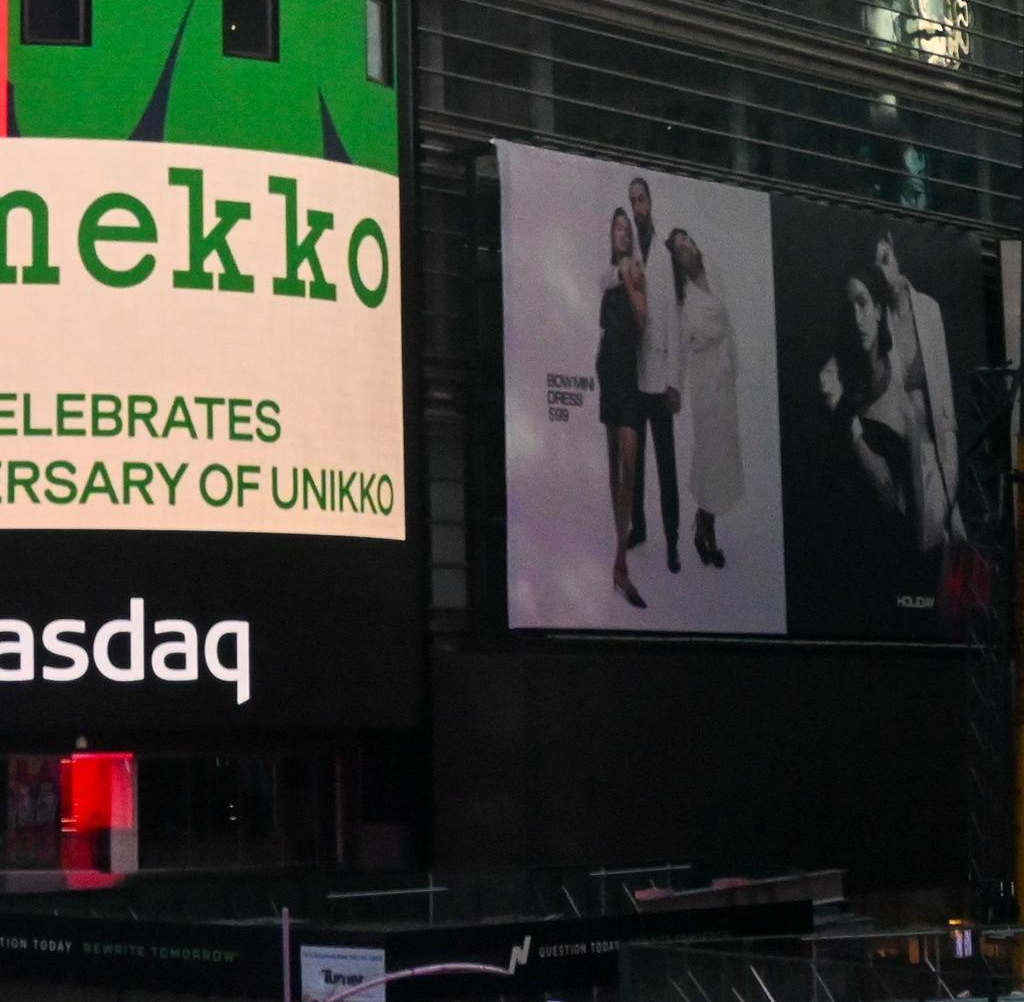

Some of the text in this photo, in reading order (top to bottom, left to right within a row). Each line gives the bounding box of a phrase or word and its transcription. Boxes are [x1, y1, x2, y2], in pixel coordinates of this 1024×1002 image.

[547, 390, 583, 407] DRESS
[199, 464, 260, 508] OF
[271, 467, 396, 517] UNIKKO
[897, 595, 935, 608] HOLIDAY
[33, 938, 73, 954] TODAY
[82, 941, 145, 958] REWRITE
[151, 945, 240, 964] TOMORROW
[538, 939, 621, 959] QUESTION TODAY
